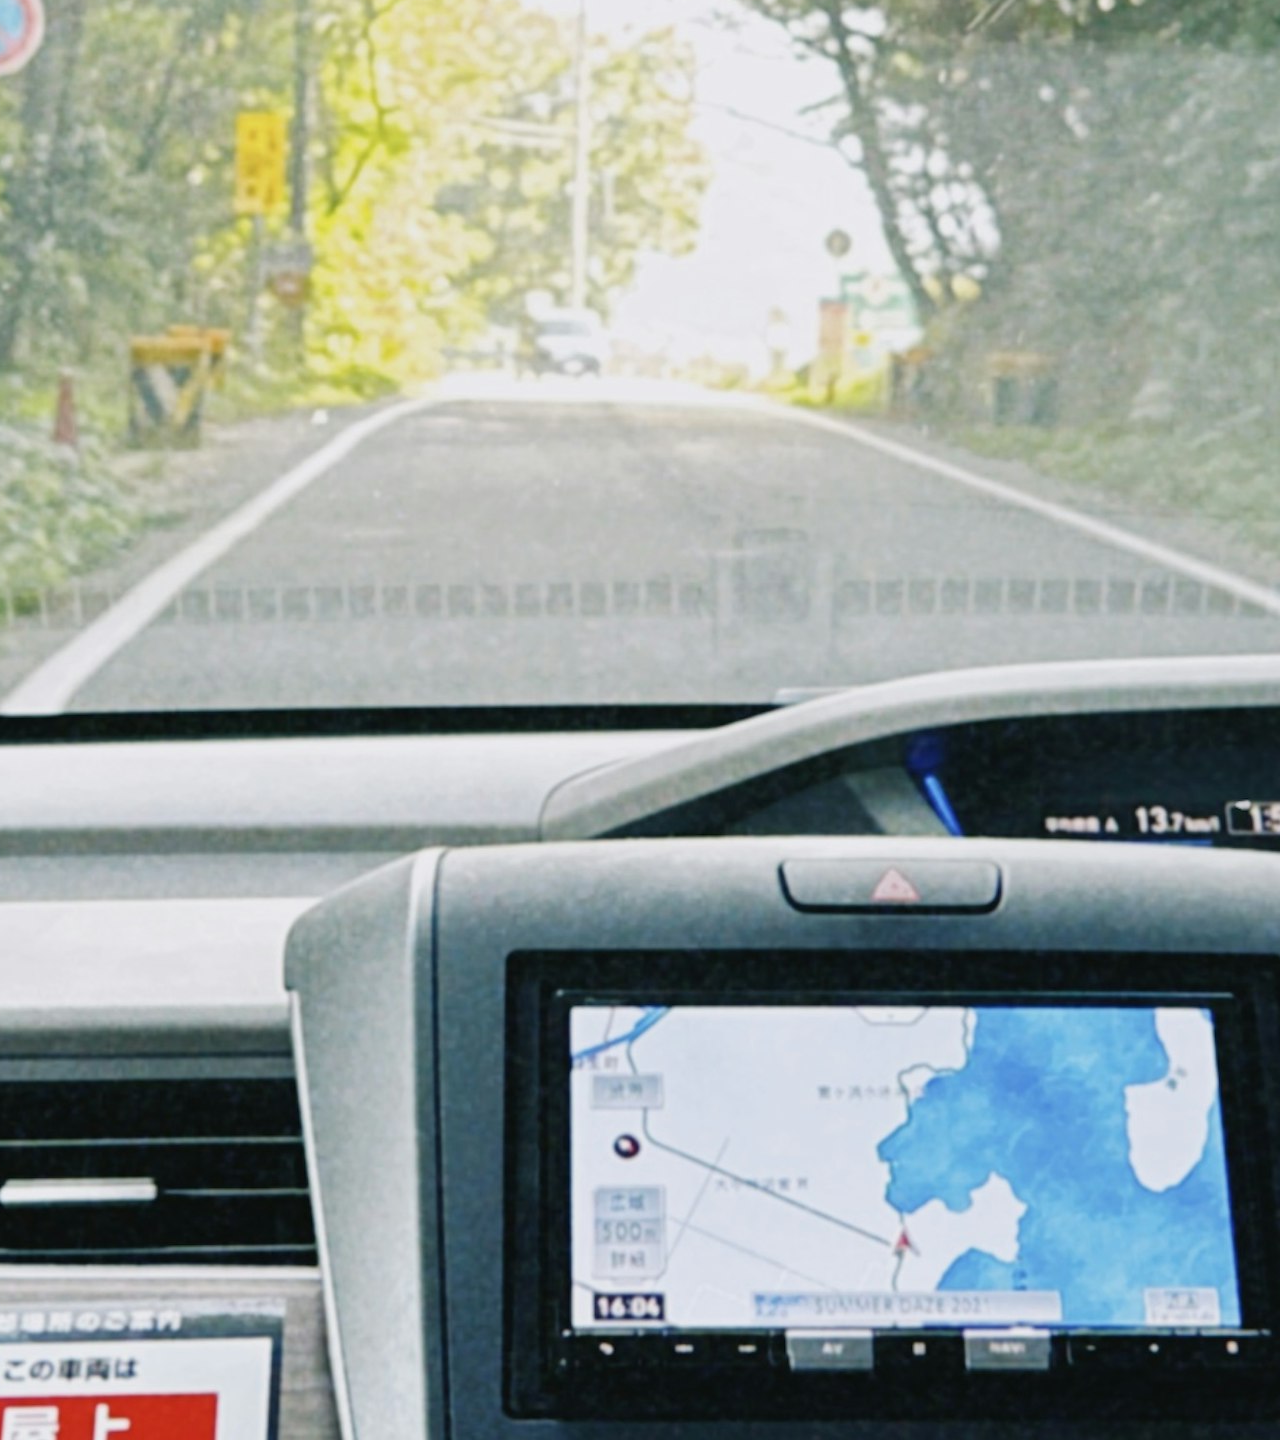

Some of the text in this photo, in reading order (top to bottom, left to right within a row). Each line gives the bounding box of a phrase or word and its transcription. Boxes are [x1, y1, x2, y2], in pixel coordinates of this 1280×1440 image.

[597, 1295, 660, 1318] 16:04
[814, 1294, 893, 1315] SUMMER
[3, 1357, 138, 1382] この車両は
